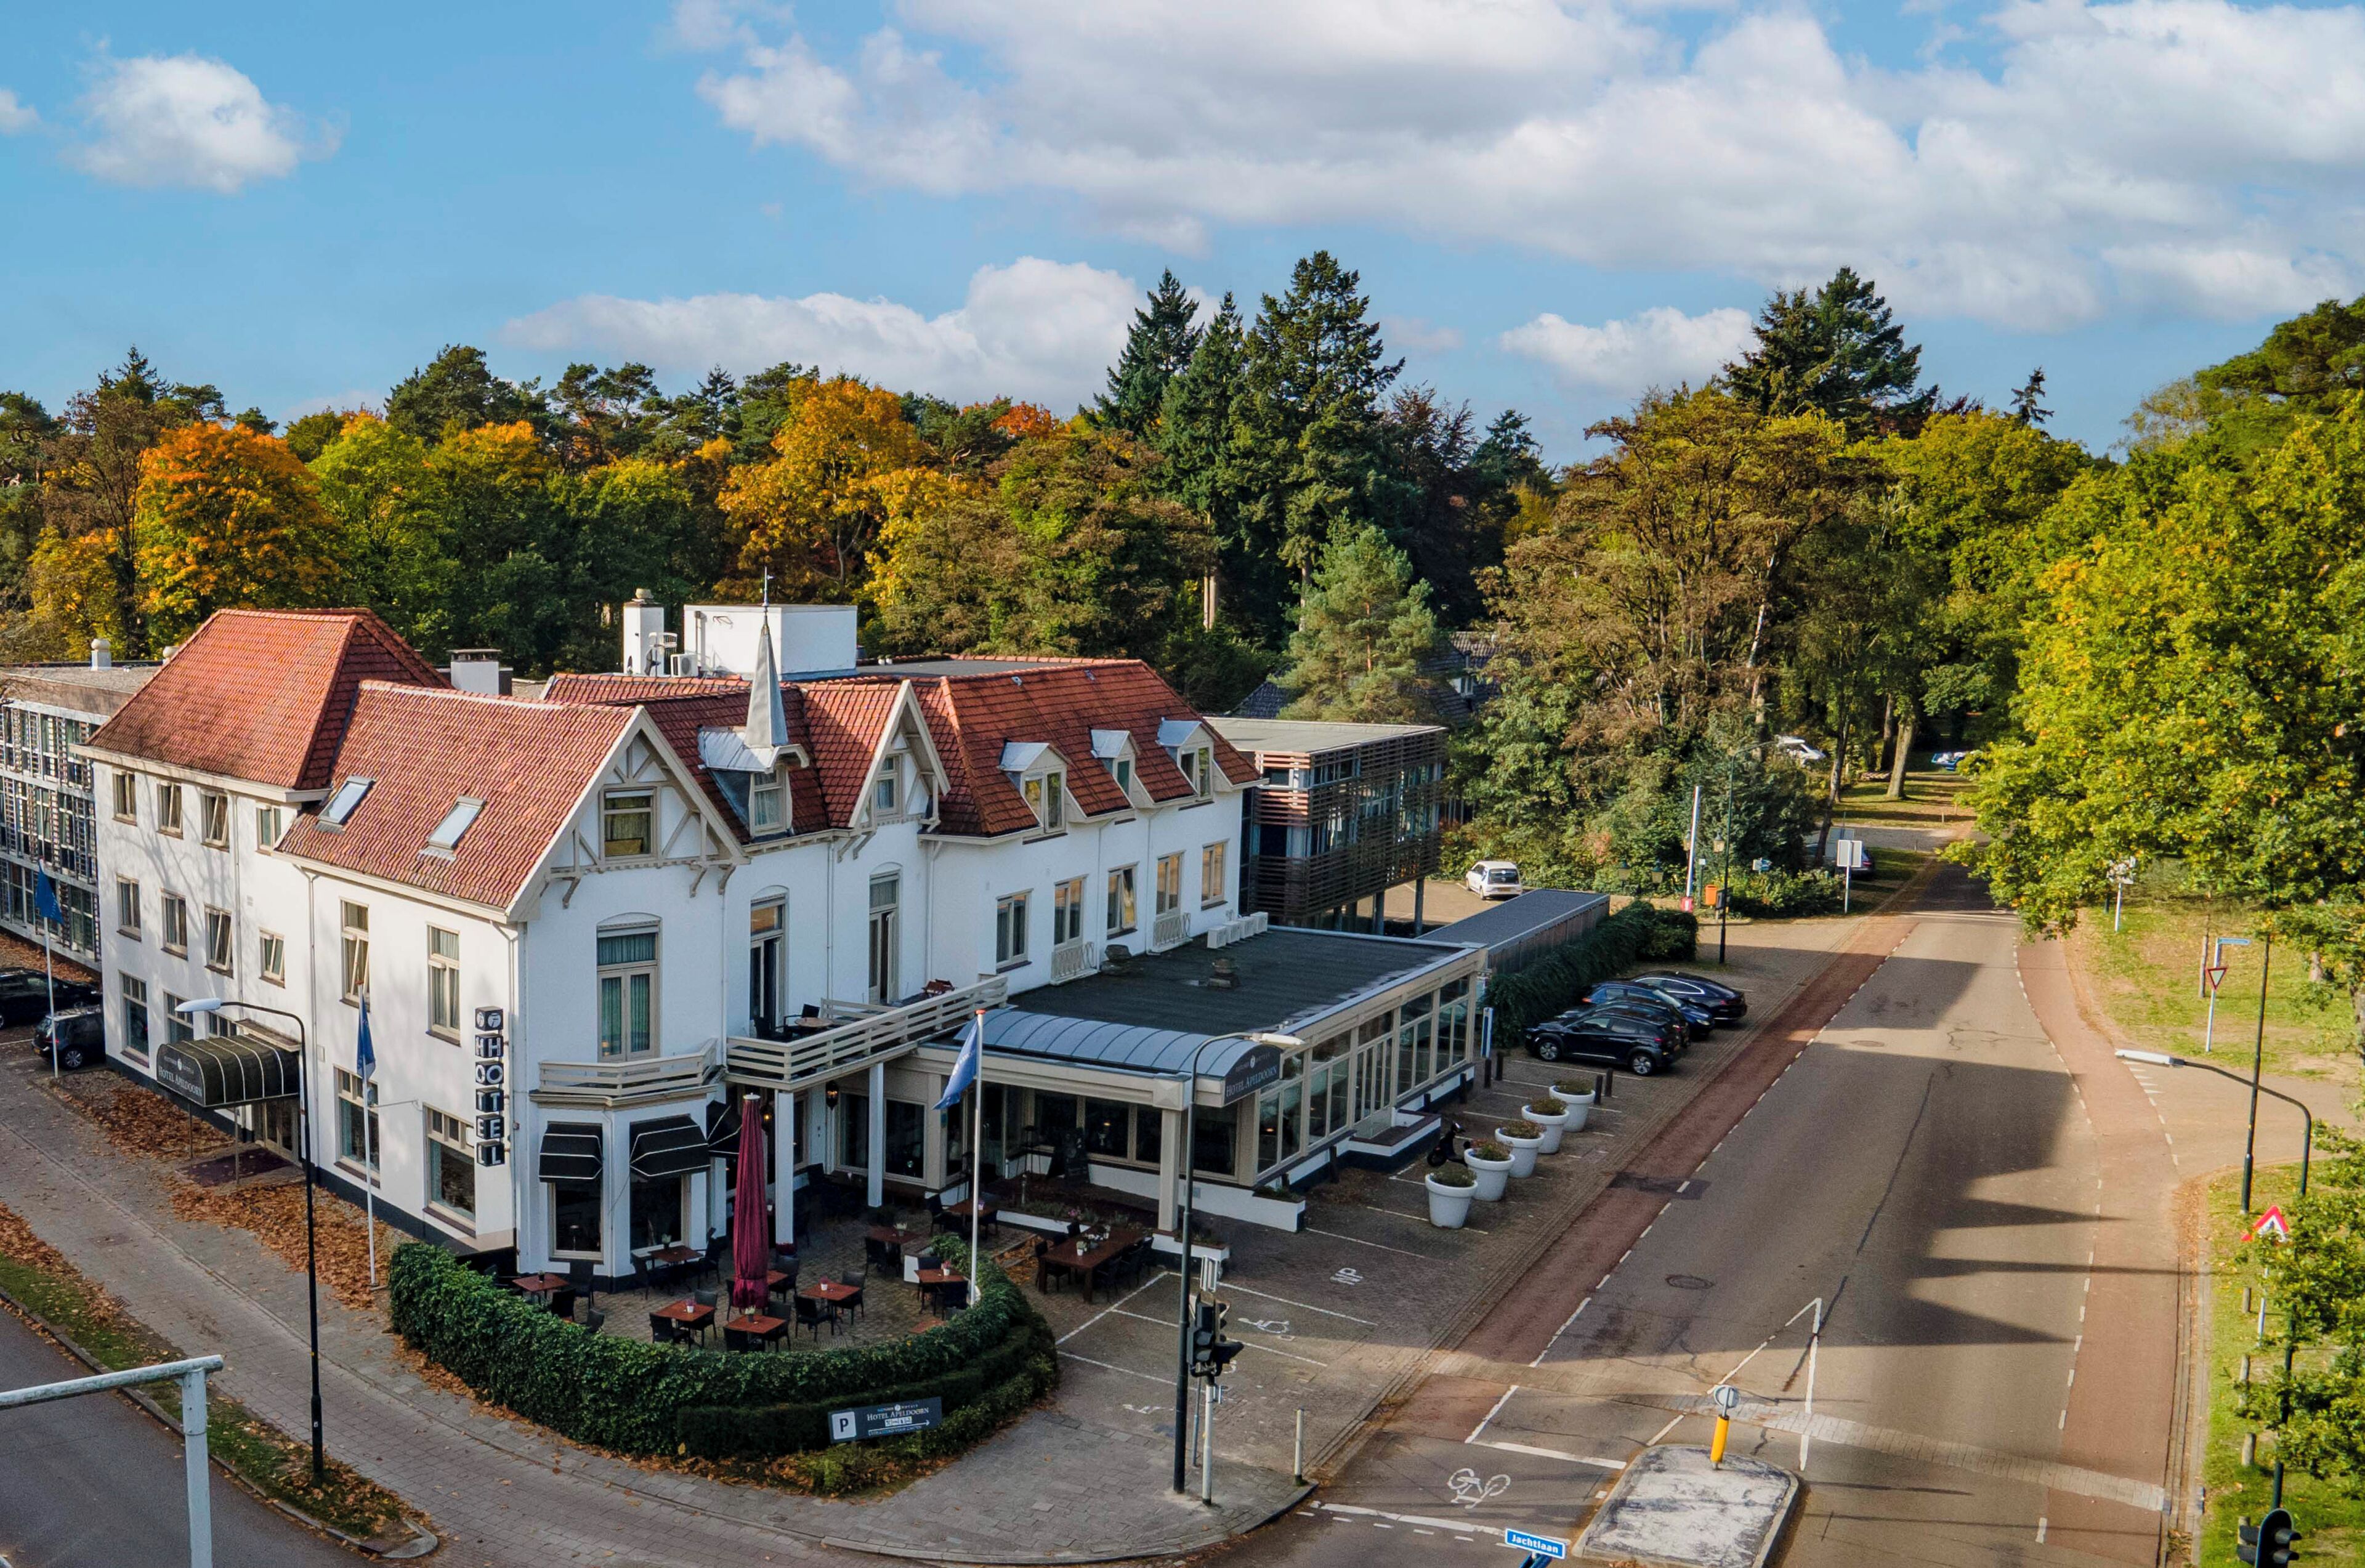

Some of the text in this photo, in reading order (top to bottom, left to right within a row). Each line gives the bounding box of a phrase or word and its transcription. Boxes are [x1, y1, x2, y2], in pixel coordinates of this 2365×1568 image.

[475, 1037, 485, 1163] HOTEL
[486, 1037, 503, 1164] HOTEL
[839, 1418, 849, 1433] P
[867, 1413, 889, 1421] HOTEL
[1512, 1534, 1559, 1553] Jachtlaan
